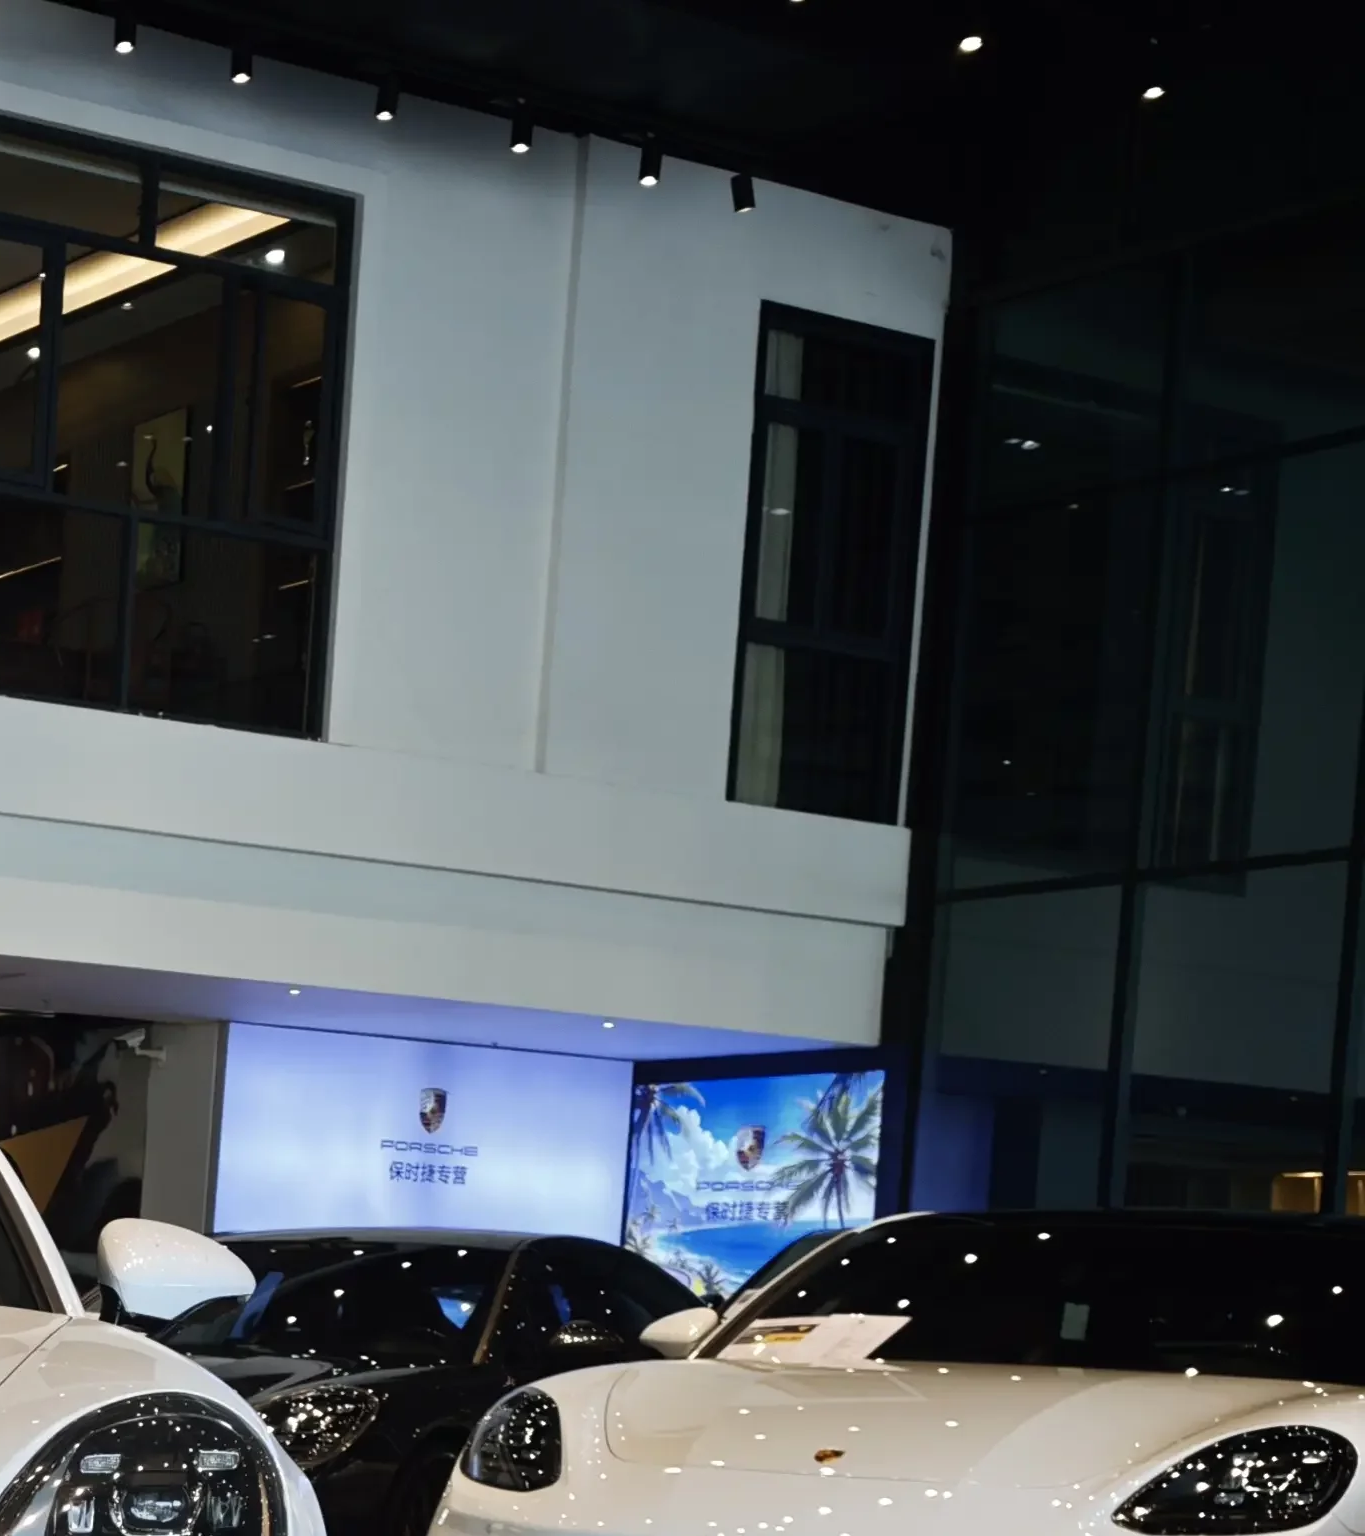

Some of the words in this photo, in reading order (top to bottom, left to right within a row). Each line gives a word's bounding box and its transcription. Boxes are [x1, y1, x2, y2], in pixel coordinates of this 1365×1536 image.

[380, 1139, 478, 1157] PORSCHE
[389, 1161, 468, 1184] 保时捷专营
[696, 1180, 801, 1193] PORSCHE
[705, 1200, 790, 1222] 保时捷专营
